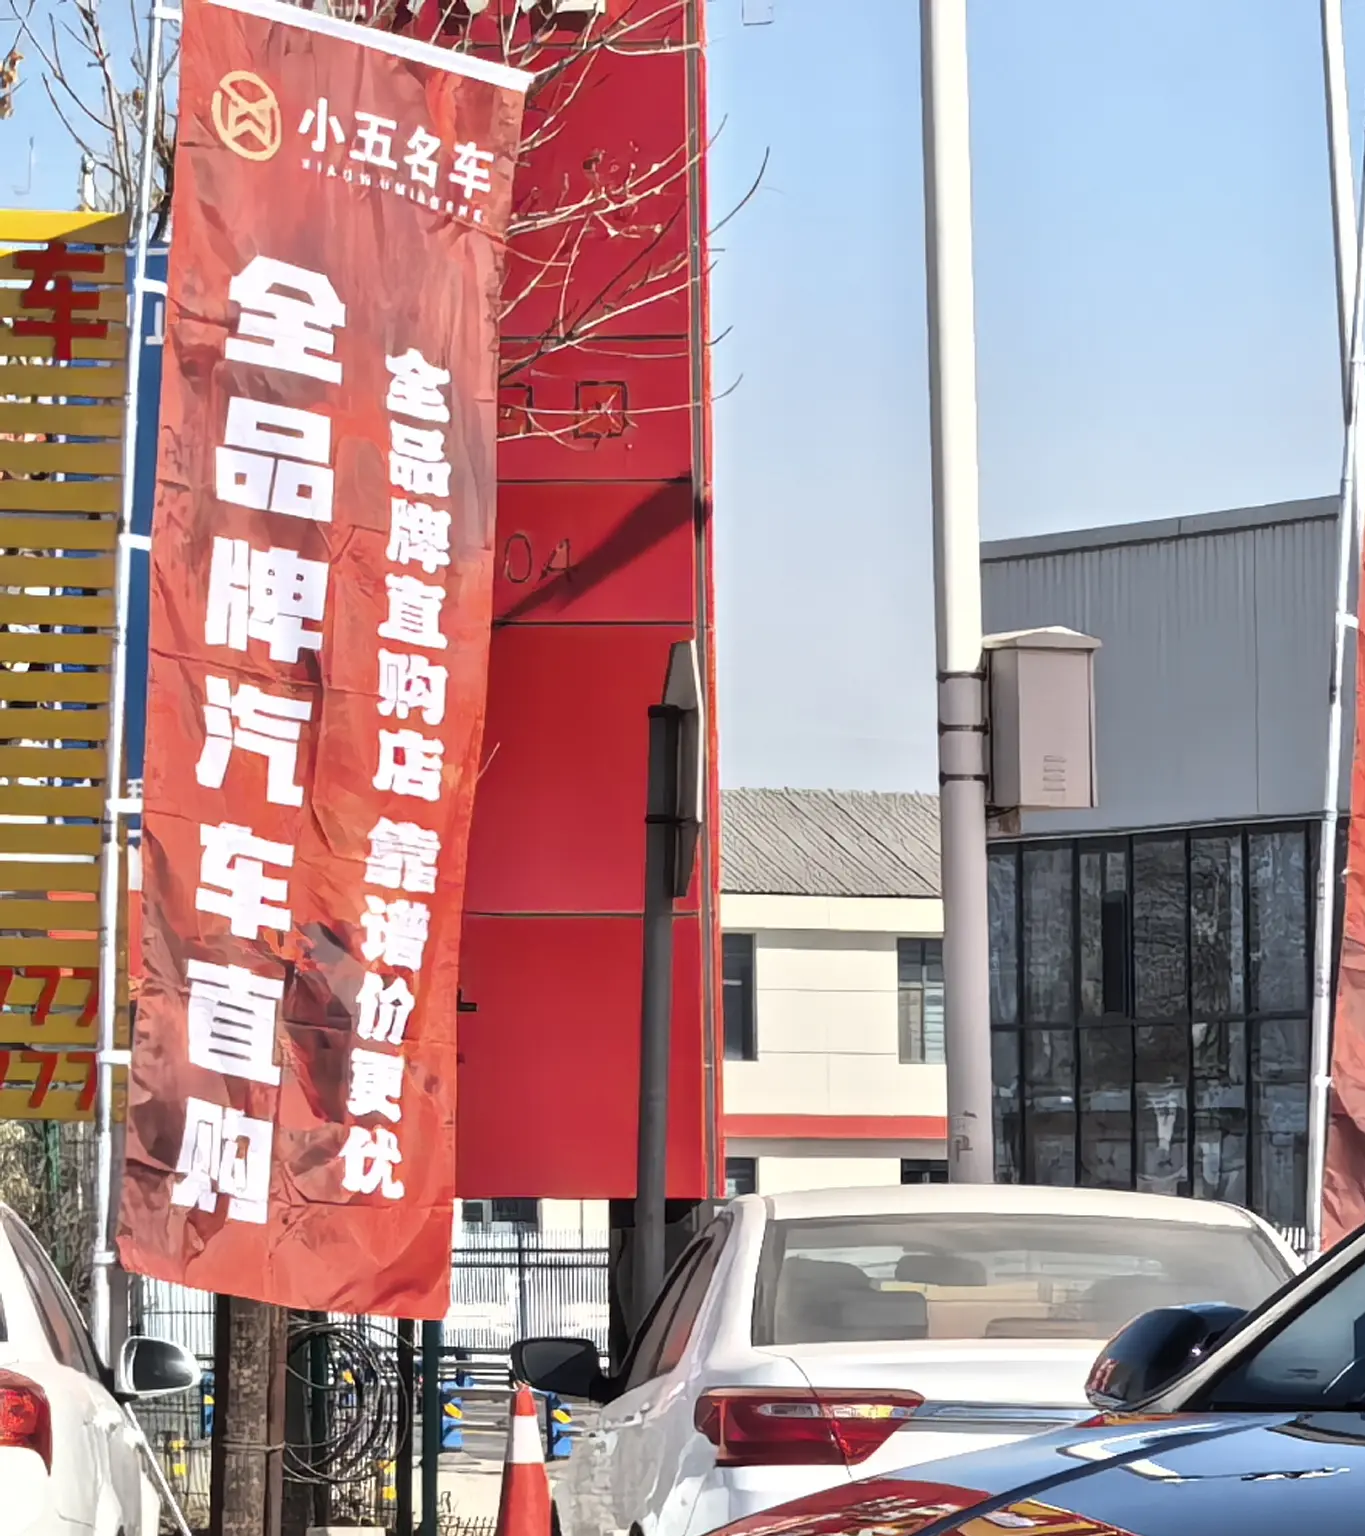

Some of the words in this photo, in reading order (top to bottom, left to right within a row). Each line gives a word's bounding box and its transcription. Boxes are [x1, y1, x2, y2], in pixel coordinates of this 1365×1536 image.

[13, 239, 108, 361] 车
[298, 97, 494, 199] 小五名车
[170, 255, 346, 1224] 全品牌汽车直购
[372, 348, 452, 801] 全品牌直购店
[339, 817, 440, 1199] 靠谱价更优
